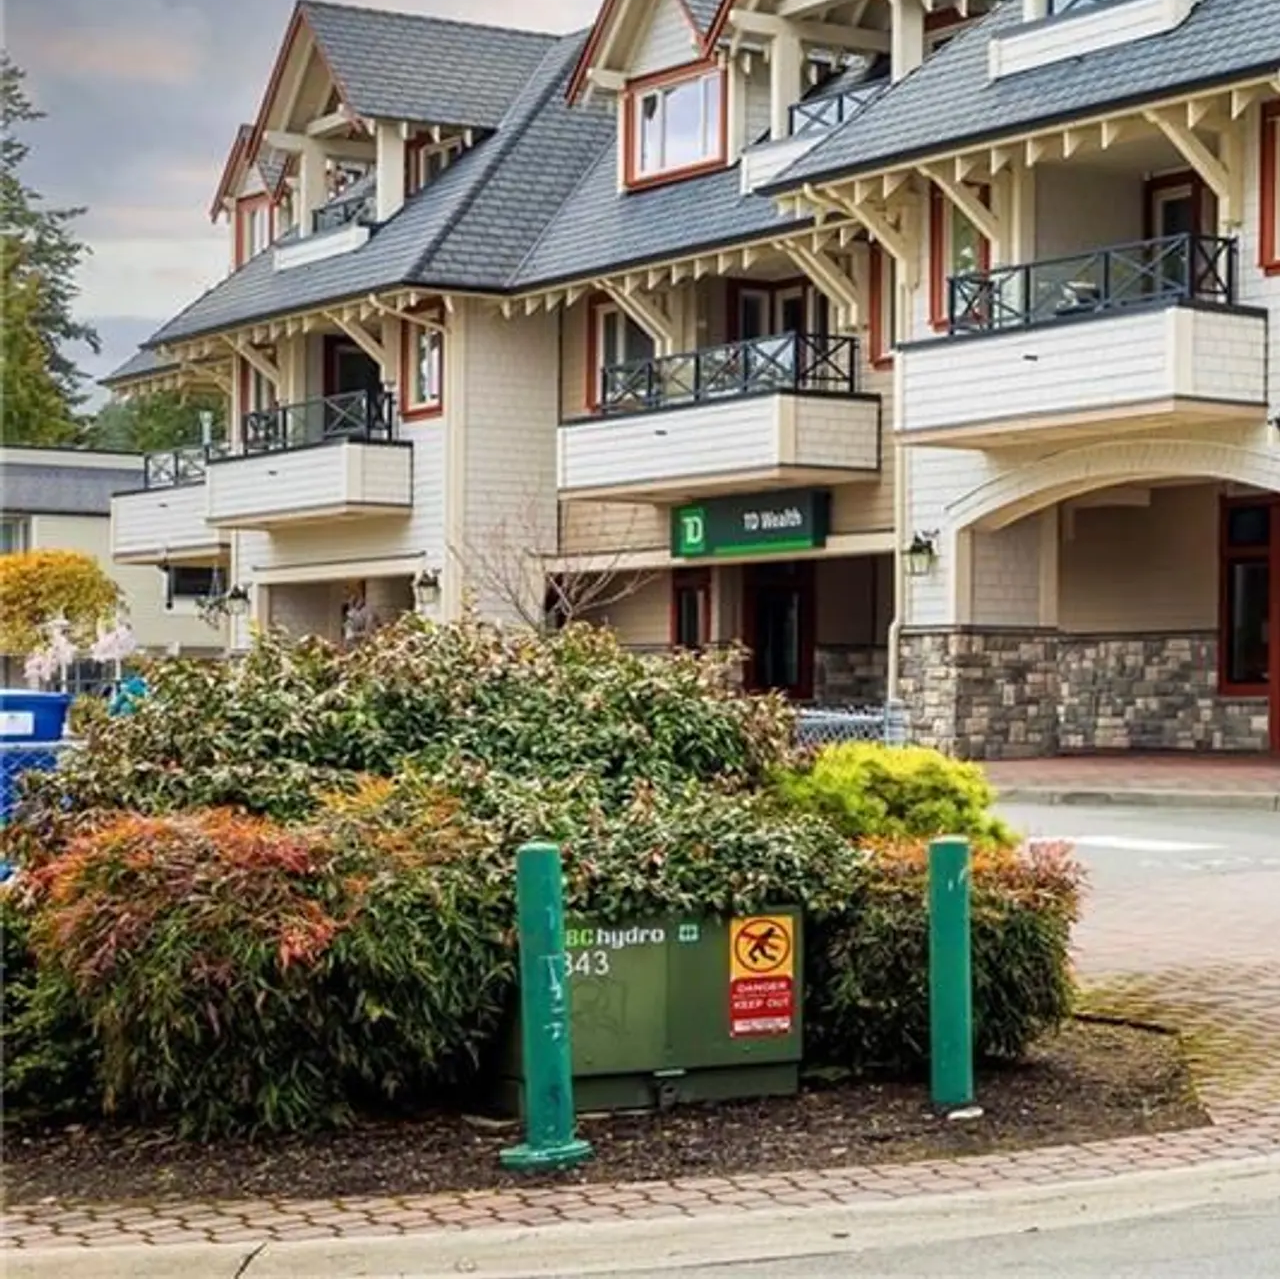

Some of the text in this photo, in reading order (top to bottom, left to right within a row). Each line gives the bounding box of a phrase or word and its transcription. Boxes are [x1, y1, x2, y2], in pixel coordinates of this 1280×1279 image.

[681, 515, 704, 544] TD
[743, 506, 803, 531] TD Wealth
[733, 997, 789, 1010] KEEP OUT
